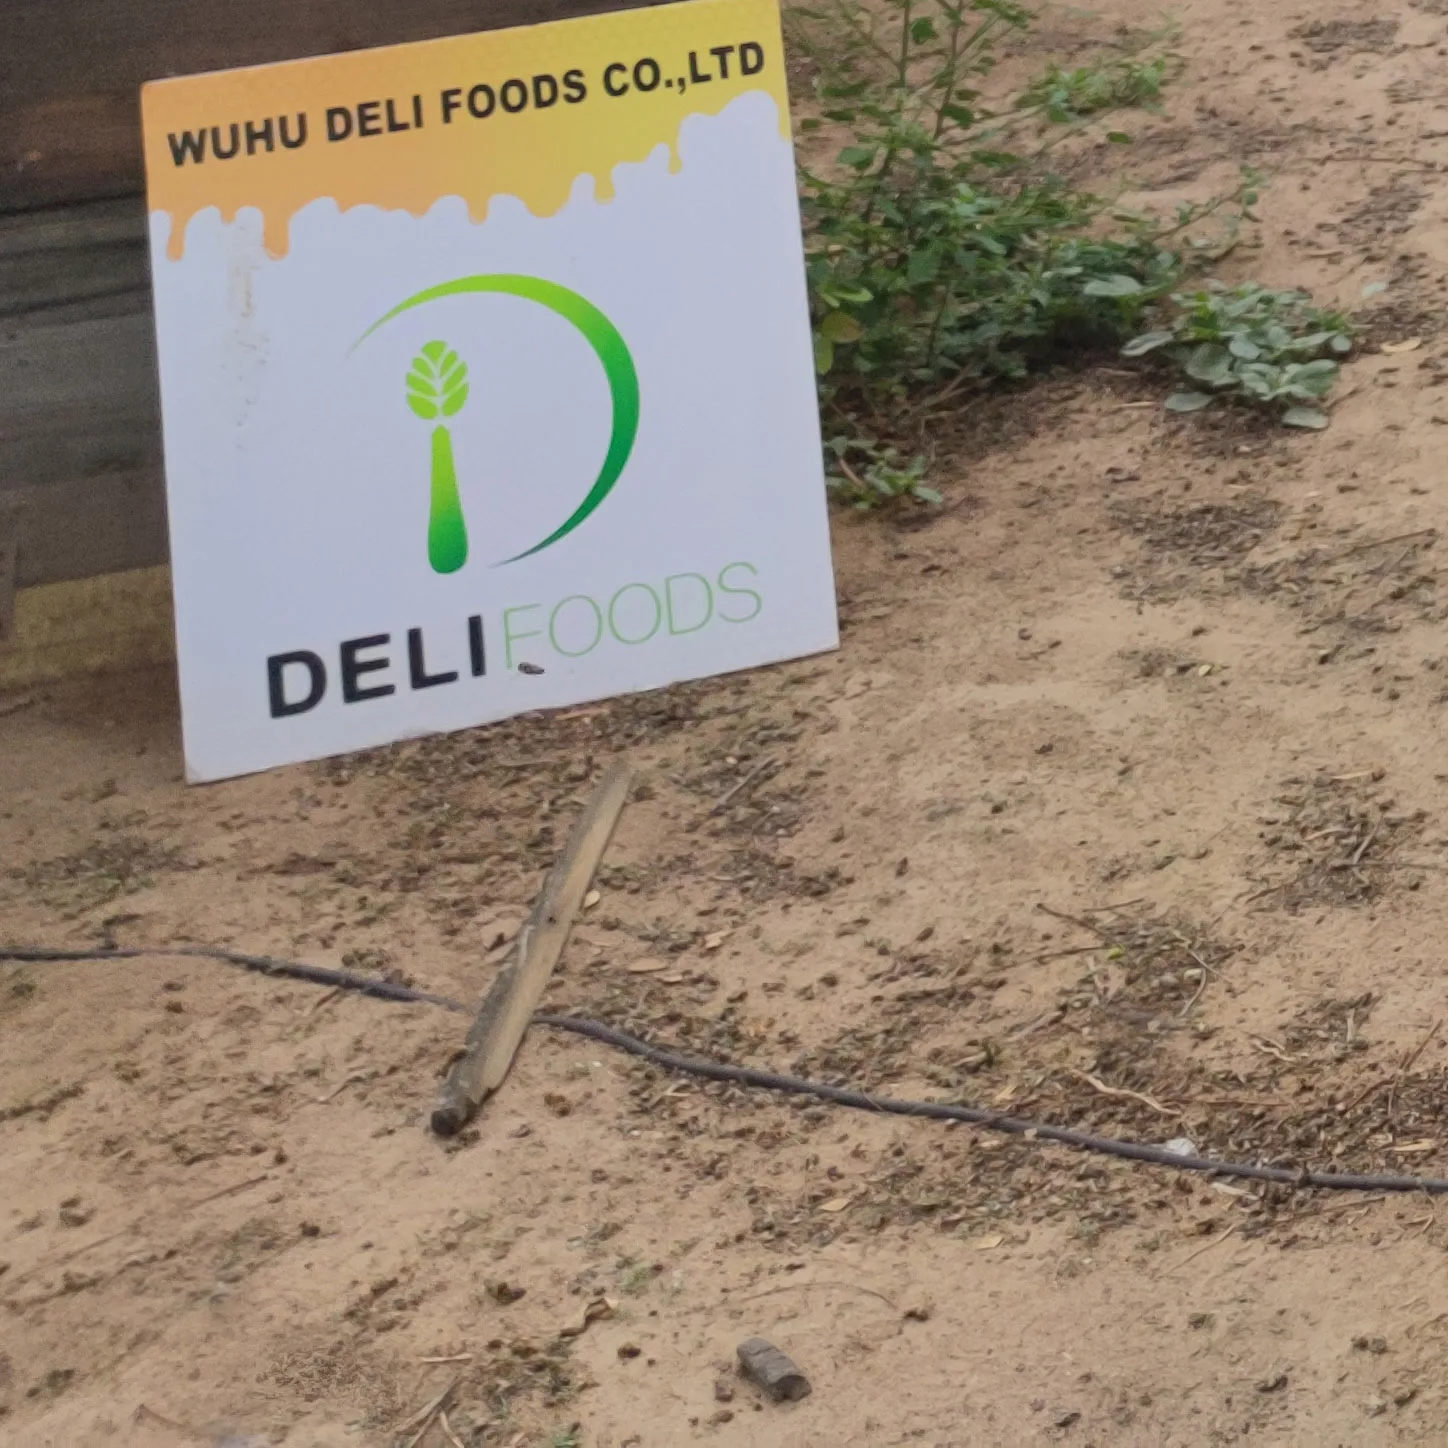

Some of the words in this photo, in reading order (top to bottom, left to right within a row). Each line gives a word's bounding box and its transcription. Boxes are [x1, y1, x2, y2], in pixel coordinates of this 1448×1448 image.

[167, 113, 308, 167] WUHU
[325, 94, 423, 143] DELI
[440, 68, 588, 125] FOODS
[602, 40, 766, 97] CO.,LTD
